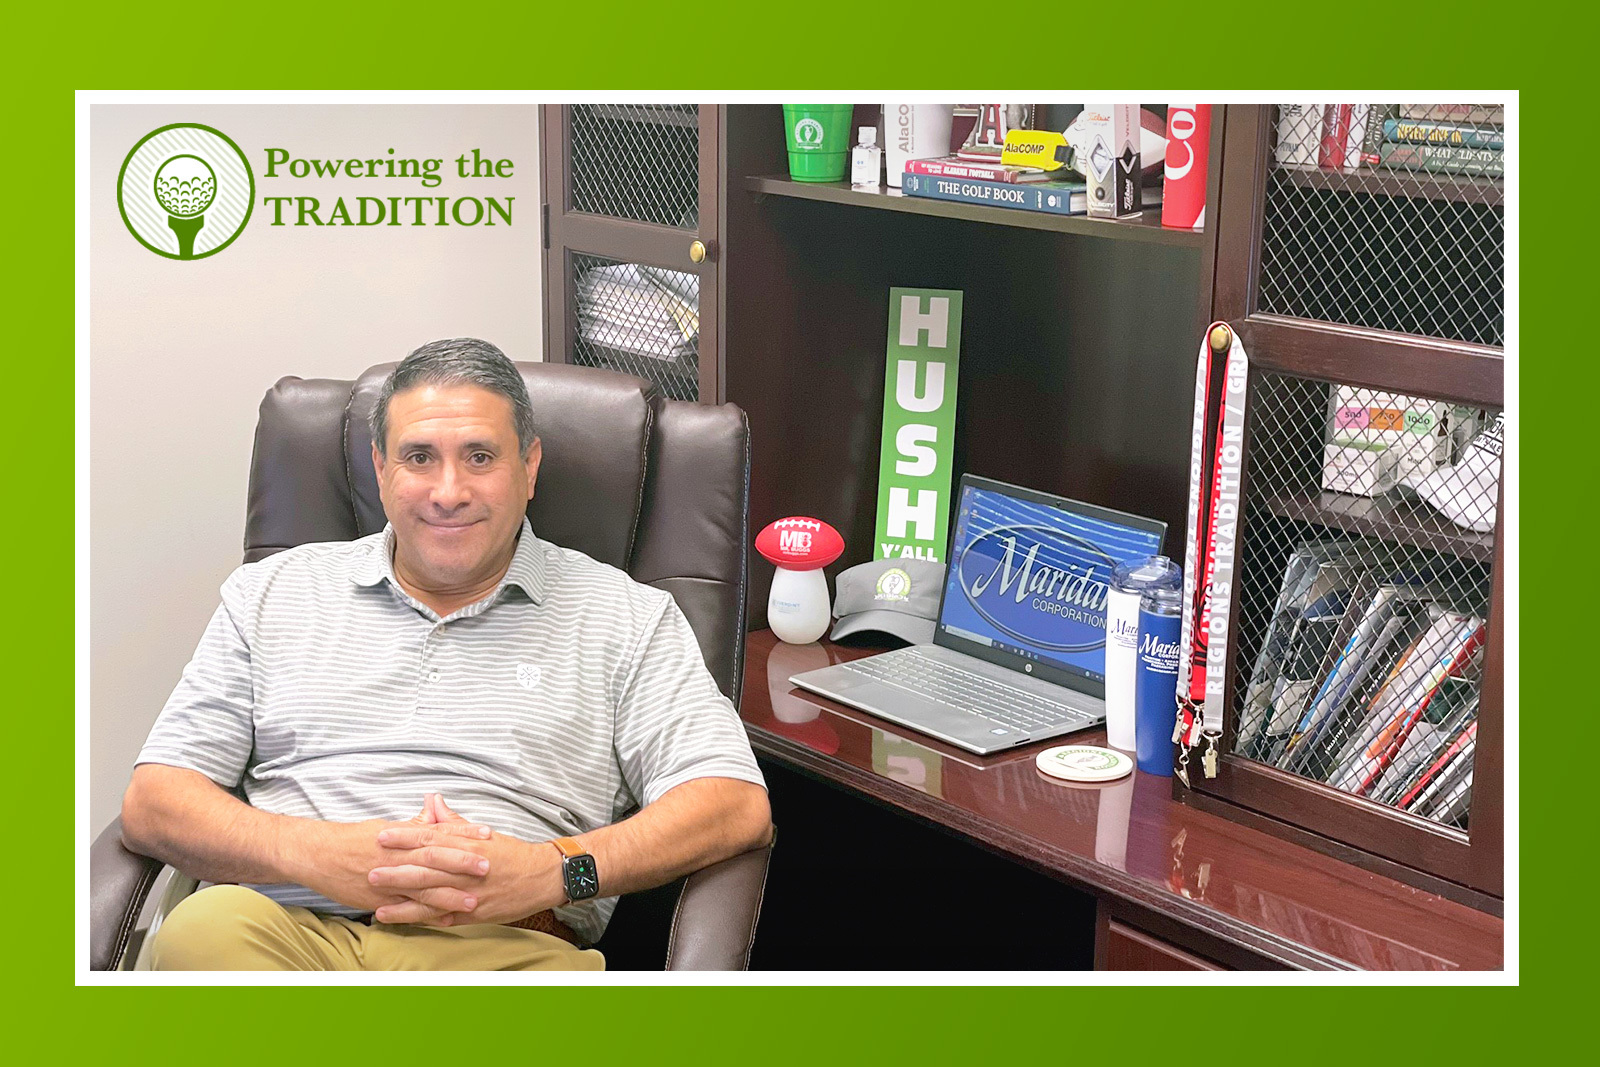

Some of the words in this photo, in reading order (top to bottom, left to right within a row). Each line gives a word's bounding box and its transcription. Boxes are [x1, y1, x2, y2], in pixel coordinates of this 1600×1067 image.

[1164, 104, 1197, 180] Co
[1451, 130, 1462, 143] IN
[1004, 143, 1045, 154] AlaCOMP
[1424, 147, 1451, 159] WHAT
[943, 166, 968, 176] ALABAMA
[968, 169, 995, 179] FOOTBALL
[937, 181, 960, 195] THE
[962, 183, 991, 200] GOLF
[993, 188, 1025, 204] BOOK
[886, 295, 949, 541] HUSH
[1408, 415, 1430, 425] 1000
[1215, 425, 1241, 572] TRADITION
[881, 543, 938, 562] Y'ALL
[1181, 526, 1198, 669] TRADITION
[1032, 598, 1107, 629] CORPORATION
[1206, 581, 1230, 694] REGIONS
